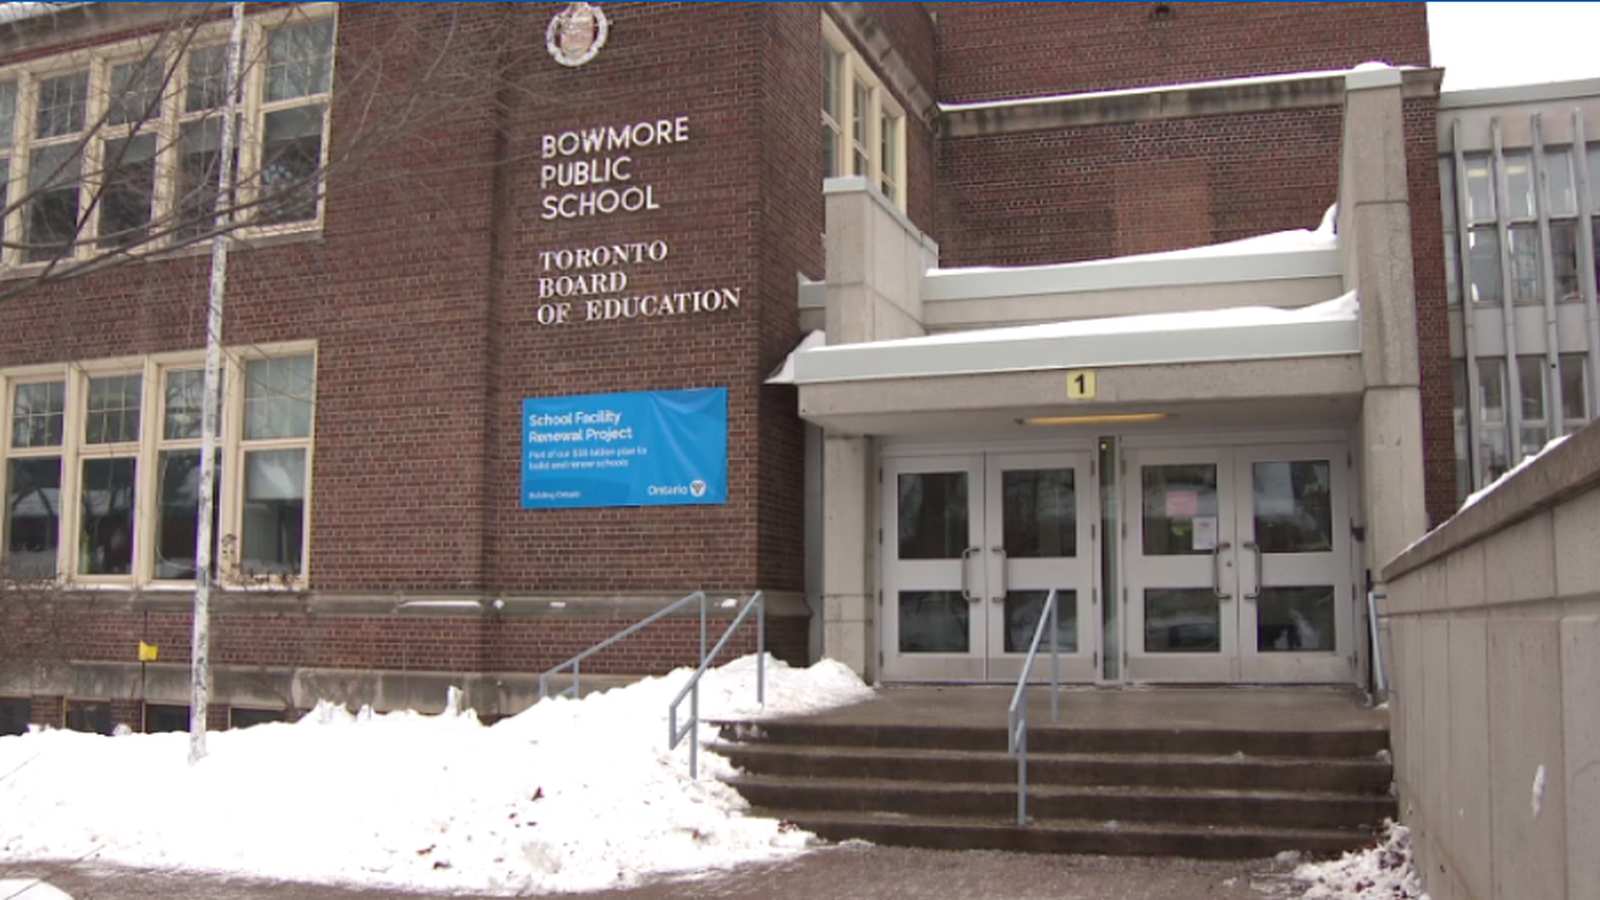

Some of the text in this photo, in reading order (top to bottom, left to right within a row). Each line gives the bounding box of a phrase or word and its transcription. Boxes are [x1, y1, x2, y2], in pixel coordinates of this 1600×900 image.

[541, 116, 690, 159] BOWMORE
[540, 155, 632, 189] PUBLIC
[541, 185, 660, 220] SCHOOL
[539, 239, 668, 271] TORONTO
[538, 271, 628, 299] BOARD
[537, 287, 741, 325] OF EDUCATION
[1074, 373, 1085, 395] 1
[528, 409, 623, 427] School Facility
[528, 426, 633, 444] Renewal Project
[647, 484, 688, 496] Ontario
